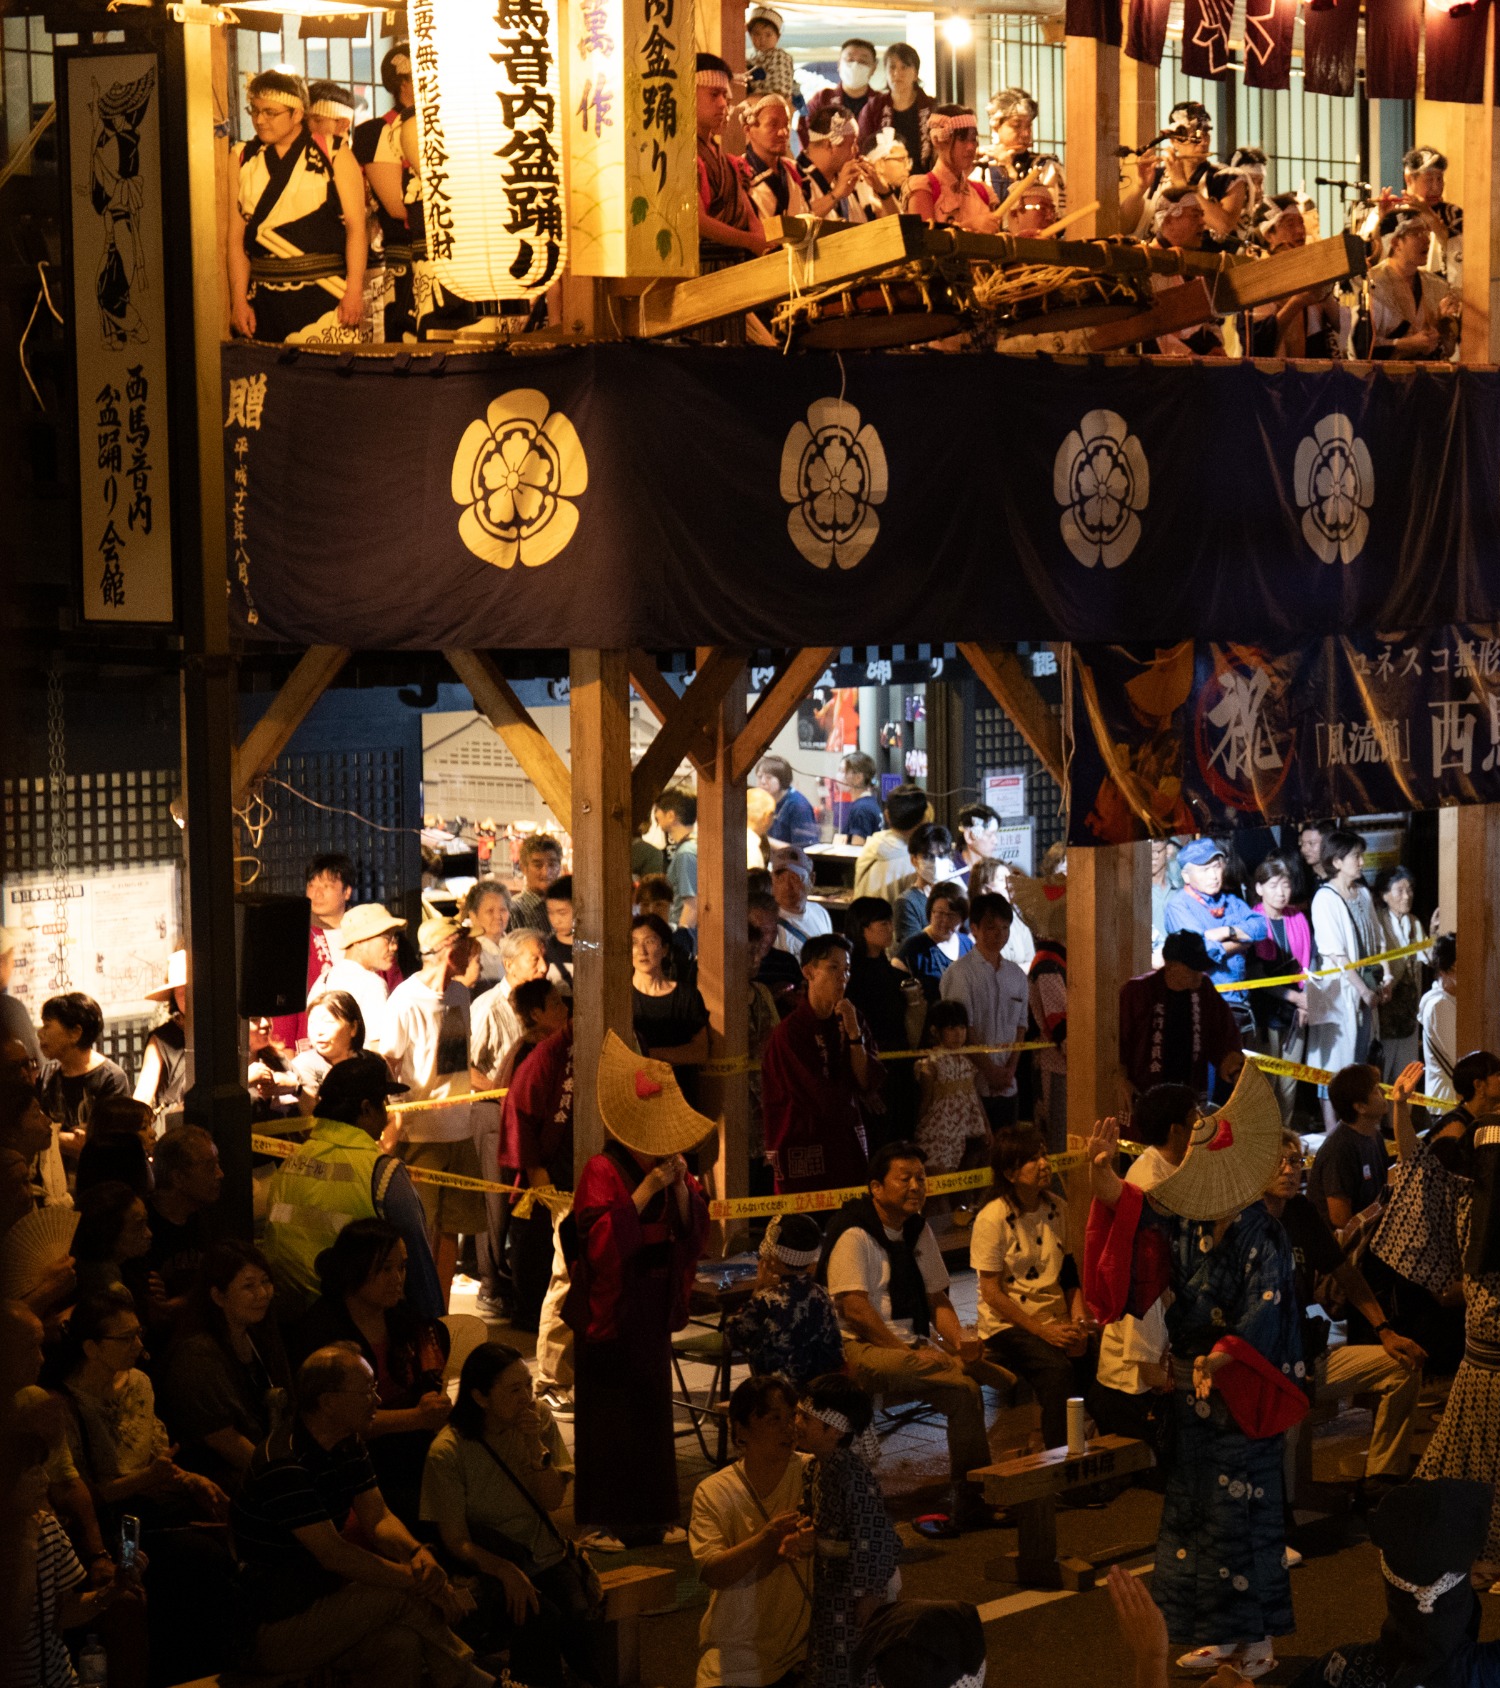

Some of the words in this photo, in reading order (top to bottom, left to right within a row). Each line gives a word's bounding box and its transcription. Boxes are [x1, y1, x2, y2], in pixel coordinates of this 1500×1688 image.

[126, 364, 153, 535] 西馬音内
[224, 373, 268, 431] 贈
[96, 384, 126, 608] 盆踊り会館
[1206, 667, 1284, 780] 祝
[795, 1191, 836, 1211] 立入禁止
